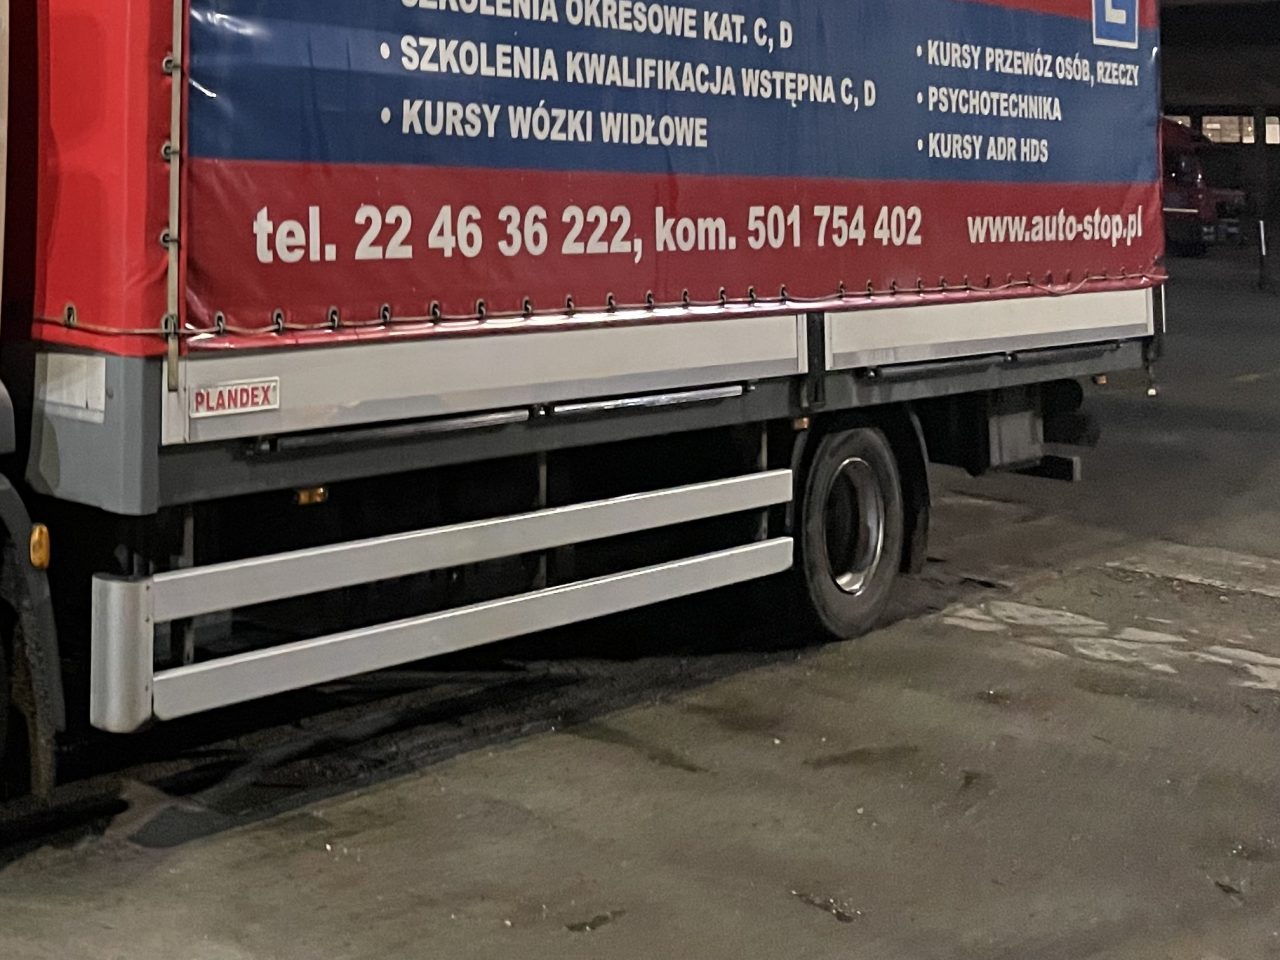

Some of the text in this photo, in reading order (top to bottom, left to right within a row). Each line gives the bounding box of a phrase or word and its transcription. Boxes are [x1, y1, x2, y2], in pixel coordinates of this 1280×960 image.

[704, 10, 748, 44] KAT.
[754, 17, 774, 54] C,
[780, 20, 793, 49] D
[400, 35, 876, 112] SZKOLENIA KWALIFIKACJA WSTĘPNA C, D
[928, 40, 1139, 88] KURSY PRZEWÓZ OSÓB, RZECZY
[402, 99, 708, 148] KURSY WÓZKI WIDŁOWE
[928, 86, 1062, 121] PSYCHOTECHNIKA
[928, 132, 1049, 163] KURSY ADR HDS
[252, 203, 922, 265] tel. 22 46 36 222, kom. 501 754 402
[967, 205, 1144, 248] www.auto-stop.pl
[195, 385, 272, 412] PLANDEX
